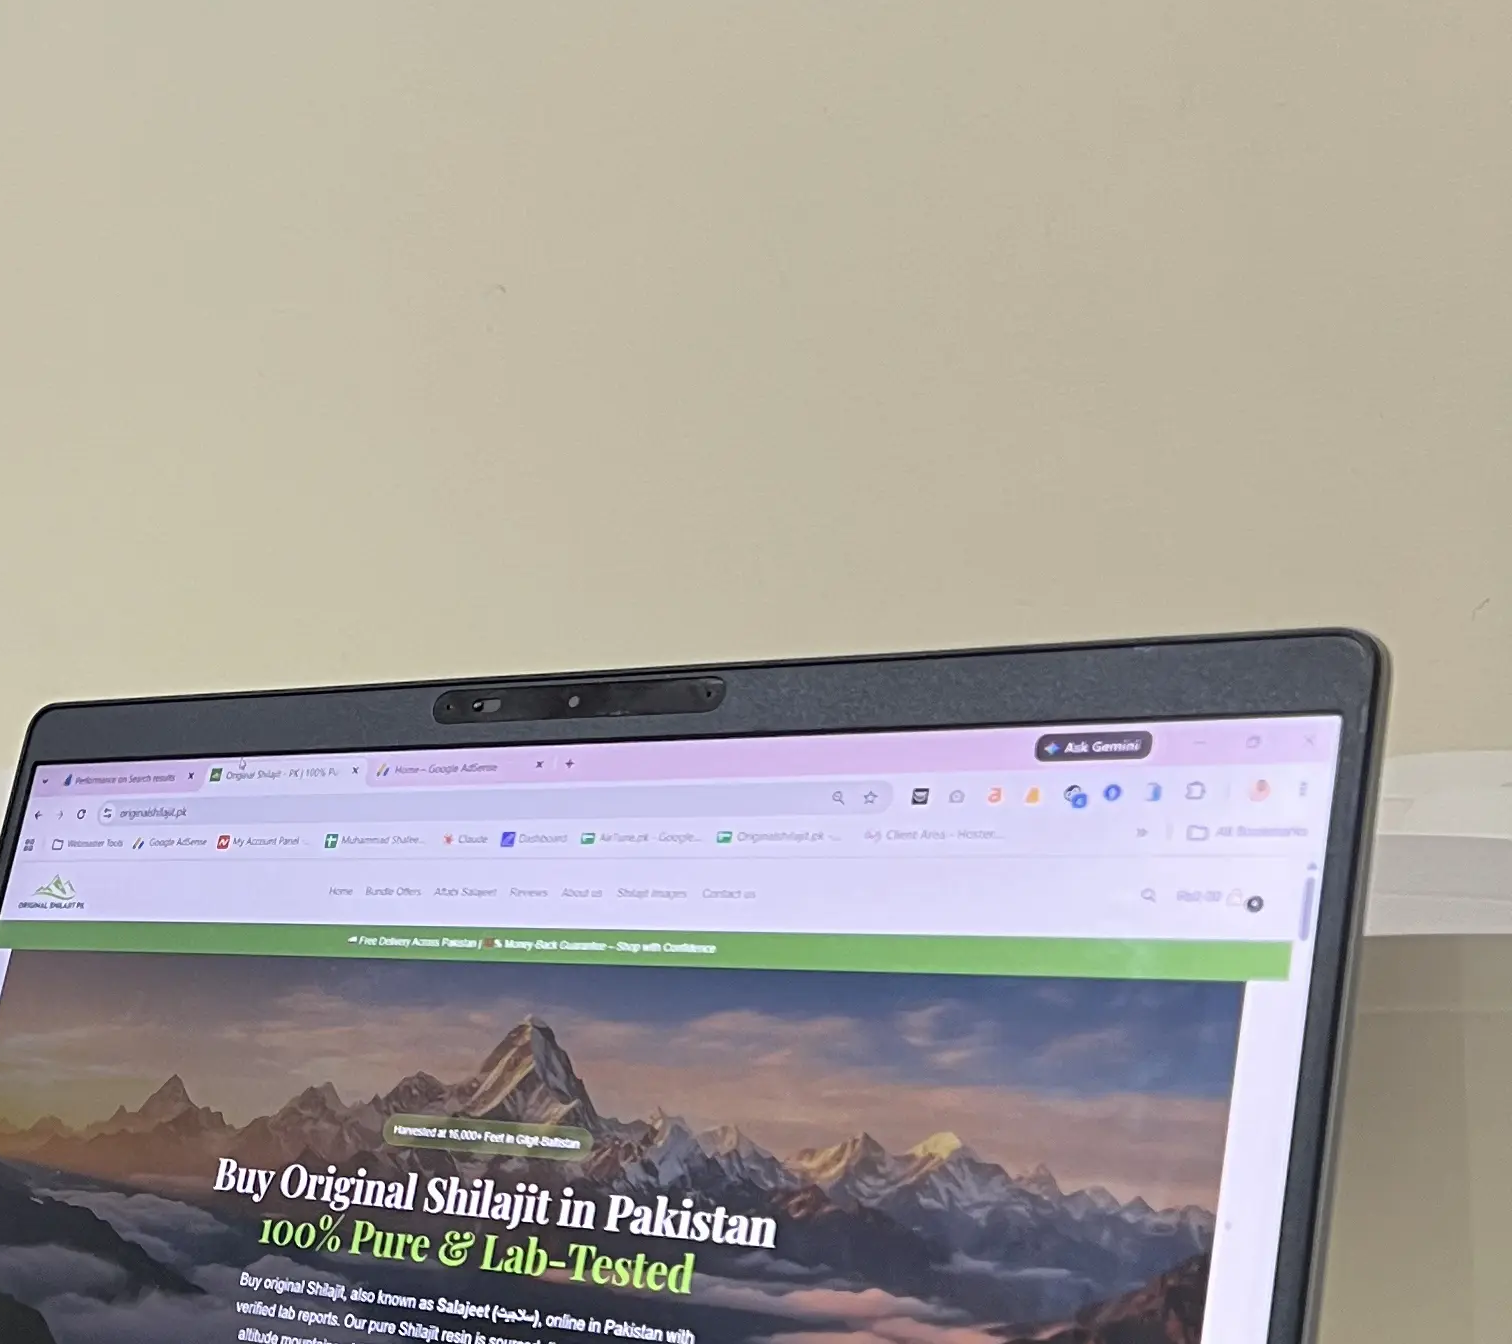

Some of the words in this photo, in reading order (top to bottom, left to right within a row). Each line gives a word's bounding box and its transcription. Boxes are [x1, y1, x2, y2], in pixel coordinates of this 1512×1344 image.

[1063, 741, 1089, 753] Ask
[1090, 740, 1142, 753] Gemini
[212, 1157, 275, 1203] Buy
[279, 1163, 419, 1211] Original
[422, 1176, 552, 1227] Shilajit
[555, 1186, 596, 1230] in
[601, 1194, 777, 1249] Pakistan
[257, 1211, 346, 1254] 100%
[347, 1220, 431, 1264] Pure
[436, 1230, 476, 1267] &
[478, 1233, 696, 1295] Lab-Tested
[235, 1300, 277, 1318] verified
[277, 1304, 296, 1321] lab
[296, 1309, 341, 1327] reports.
[342, 1313, 368, 1330] Our
[368, 1319, 397, 1335] pure
[397, 1320, 440, 1343] Shilajit
[238, 1271, 261, 1291] Buy
[262, 1276, 306, 1295] original
[305, 1280, 347, 1302] Shilajit,
[349, 1287, 376, 1304] also
[375, 1289, 417, 1309] known
[417, 1298, 435, 1312] as
[436, 1297, 490, 1320] Salajeet
[544, 1313, 587, 1332] online
[587, 1316, 602, 1334] in
[602, 1318, 662, 1342] Pakistan
